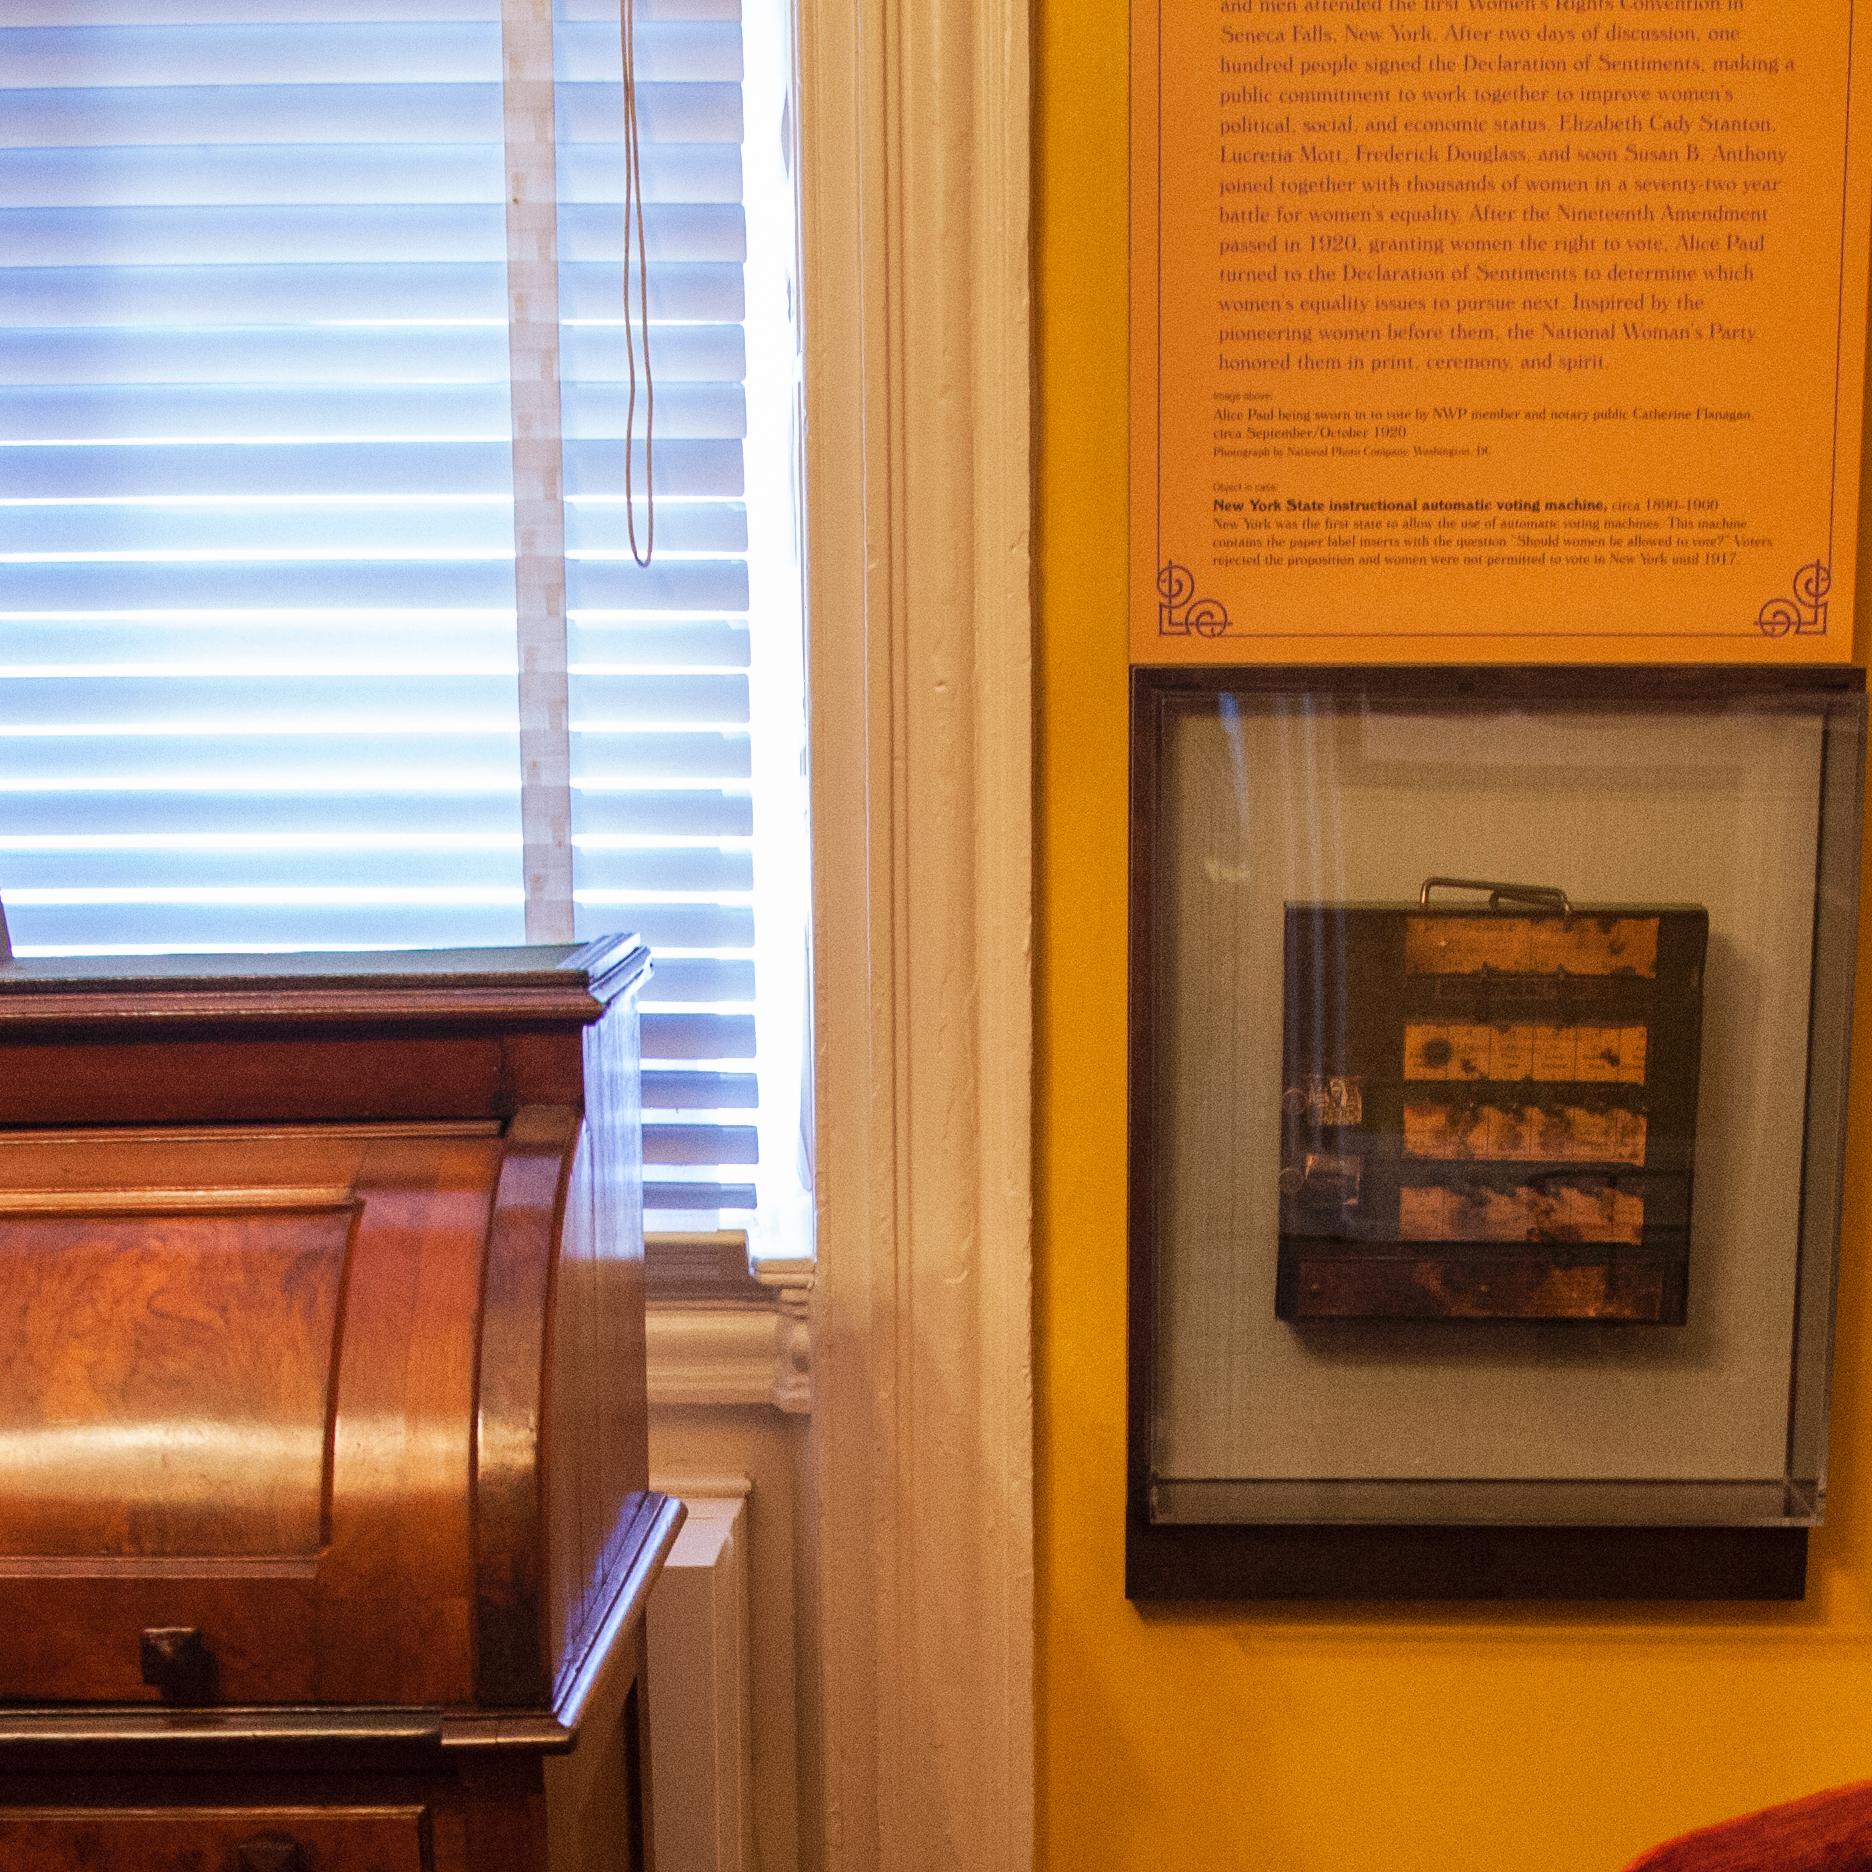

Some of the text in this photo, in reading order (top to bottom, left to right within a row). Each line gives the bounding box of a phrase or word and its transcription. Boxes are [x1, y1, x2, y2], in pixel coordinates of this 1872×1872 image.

[1220, 25, 1285, 43] Seneca
[1345, 24, 1382, 42] New
[1444, 24, 1492, 42] After
[1499, 29, 1530, 41] two
[1536, 24, 1575, 44] days
[1582, 23, 1600, 41] of
[1708, 28, 1740, 41] one
[1220, 55, 1293, 74] hundred
[1301, 54, 1357, 77] people
[1365, 54, 1421, 75] signed
[1429, 54, 1456, 71] the
[1464, 53, 1567, 72] Declaration
[1573, 54, 1592, 72] of
[1713, 53, 1779, 75] making
[1784, 58, 1795, 72] a
[1219, 86, 1272, 108] public
[1279, 89, 1390, 104] commitment
[1398, 88, 1416, 102] to
[1422, 84, 1466, 102] work
[1474, 84, 1549, 104] together
[1556, 89, 1574, 103] to
[1580, 88, 1651, 106] improve
[1365, 115, 1397, 133] and
[1404, 119, 1487, 133] economic
[1560, 113, 1642, 132] Elizabeth
[1649, 114, 1693, 135] Cady
[1220, 145, 1293, 164] Lucretia
[1356, 144, 1439, 163] Frederick
[1538, 144, 1570, 162] and
[1577, 150, 1617, 162] soon
[1625, 144, 1679, 162] Susan
[1713, 144, 1787, 165] Anthony
[1219, 174, 1782, 198] joined together with thousands of women in a seventy-two year
[1219, 205, 1270, 224] battle
[1277, 205, 1302, 223] for
[1470, 204, 1516, 222] After
[1523, 205, 1549, 222] the
[1558, 203, 1654, 222] Nineteenth
[1661, 203, 1767, 222] Amendment
[1219, 235, 1277, 256] passed
[1285, 238, 1300, 252] in
[1369, 237, 1444, 256] granting
[1450, 240, 1512, 252] women
[1520, 234, 1547, 252] the
[1554, 234, 1595, 255] right
[1604, 237, 1621, 251] to
[1676, 233, 1719, 251] Alice
[1727, 233, 1765, 252] Paul
[1219, 263, 1754, 283] turned to the Declaration of Sentiments to determine which
[1300, 294, 1367, 315] equality
[1375, 297, 1426, 311] issues
[1433, 298, 1450, 311] to
[1456, 299, 1515, 315] pursue
[1573, 292, 1644, 313] Inspired
[1651, 293, 1668, 313] by
[1677, 292, 1704, 310] the
[1219, 327, 1312, 345] pioneering
[1319, 329, 1381, 341] women
[1388, 323, 1442, 341] before
[1507, 323, 1534, 340] the
[1542, 322, 1615, 340] National
[1709, 321, 1756, 344] Party
[1219, 353, 1290, 371] honored
[1297, 353, 1342, 370] them
[1348, 356, 1364, 370] in
[1520, 353, 1552, 370] and
[1213, 499, 1244, 512] New
[1250, 499, 1281, 512] York
[1287, 499, 1324, 512] State
[1329, 499, 1417, 511] instructional
[1422, 500, 1491, 511] automatic
[1497, 500, 1540, 513] voting
